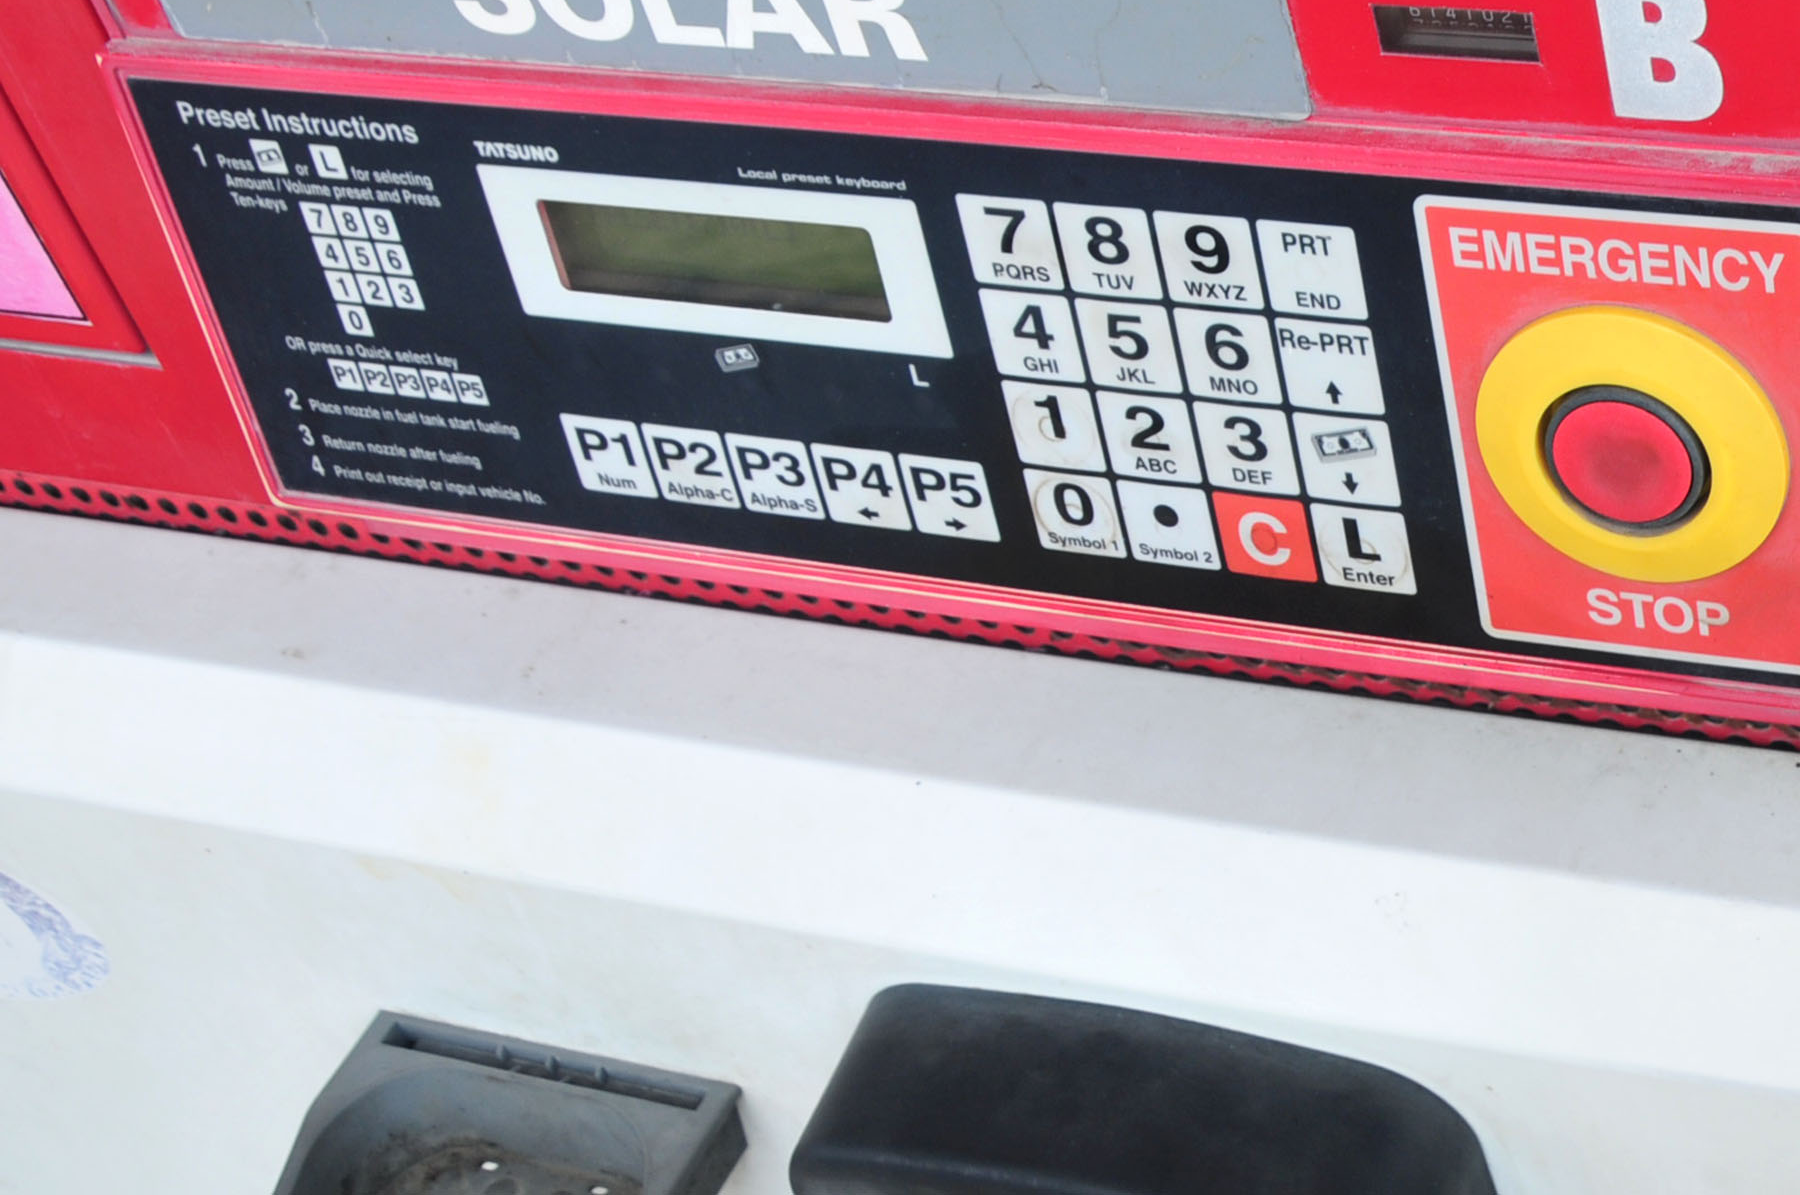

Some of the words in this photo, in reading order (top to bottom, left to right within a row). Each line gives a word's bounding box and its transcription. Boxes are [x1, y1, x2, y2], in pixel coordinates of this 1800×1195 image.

[176, 100, 259, 132] Preset
[261, 107, 419, 144] Instructions
[192, 143, 208, 167] 1
[216, 154, 254, 172] Press
[295, 164, 309, 176] or
[319, 151, 339, 173] L
[350, 166, 370, 182] for
[372, 169, 434, 191] selecting
[473, 140, 559, 164] TATSUNO
[225, 173, 275, 192] Amount
[282, 179, 331, 198] Volume
[333, 185, 374, 202] preset
[376, 189, 401, 204] and
[402, 190, 442, 208] Press
[737, 167, 778, 181] Local
[781, 171, 832, 187] preset
[835, 173, 907, 192] keyboard
[230, 191, 288, 214] Ten-keys
[309, 208, 323, 229] 7
[342, 211, 358, 232] 8
[373, 214, 390, 235] 9
[983, 206, 1026, 255] 7
[324, 243, 339, 264] 4
[357, 245, 371, 266] 5
[386, 248, 401, 269] 6
[1084, 216, 1131, 265] 8
[1184, 224, 1231, 275] 9
[1281, 232, 1332, 257] PRT
[992, 262, 1051, 283] PQRS
[1448, 226, 1785, 294] EMERGENCY
[335, 278, 349, 297] 1
[367, 280, 384, 300] 2
[398, 284, 414, 304] 3
[1092, 272, 1135, 291] TUV
[1184, 281, 1248, 302] WXYZ
[1295, 291, 1342, 311] END
[348, 310, 364, 331] 0
[1013, 304, 1055, 350] 4
[1106, 313, 1149, 361] 5
[1204, 322, 1251, 371] 6
[1279, 328, 1370, 357] Re-PRT
[285, 335, 306, 351] OR
[308, 340, 344, 355] press
[346, 345, 354, 355] a
[355, 343, 393, 361] Quick
[395, 350, 433, 365] select
[434, 353, 459, 371] key
[1023, 356, 1059, 374] GHI
[333, 365, 358, 384] P1
[363, 368, 391, 388] P2
[394, 372, 421, 391] P3
[425, 376, 452, 395] P4
[458, 380, 484, 399] P5
[908, 364, 930, 388] L
[1116, 367, 1156, 386] JKL
[1209, 376, 1259, 396] MNO
[285, 387, 302, 411] 2
[308, 398, 342, 415] Place
[344, 404, 381, 420] nozzle
[1033, 395, 1067, 440] 1
[298, 424, 315, 447] 3
[321, 434, 365, 452] Return
[367, 441, 408, 458] nozzle
[1125, 405, 1171, 452] 2
[1223, 416, 1269, 463] 3
[574, 426, 638, 468] P1
[651, 435, 723, 478] P2
[311, 455, 326, 477] 4
[333, 464, 364, 482] Print
[596, 472, 638, 491] Num
[734, 445, 806, 489] P3
[820, 456, 894, 499] P4
[1134, 456, 1178, 476] ABC
[1231, 467, 1273, 486] DEF
[667, 481, 735, 504] Alpha-C
[909, 466, 983, 509] P5
[750, 492, 818, 515] Alpha-S
[1053, 482, 1095, 527] 0
[1048, 531, 1107, 553] Symbol
[1112, 538, 1120, 552] 1
[1138, 543, 1199, 563] Symbol
[1202, 550, 1213, 564] 2
[1237, 511, 1291, 566] C
[1342, 517, 1382, 562] L
[1341, 566, 1395, 587] Enter
[1586, 588, 1730, 637] STOP
